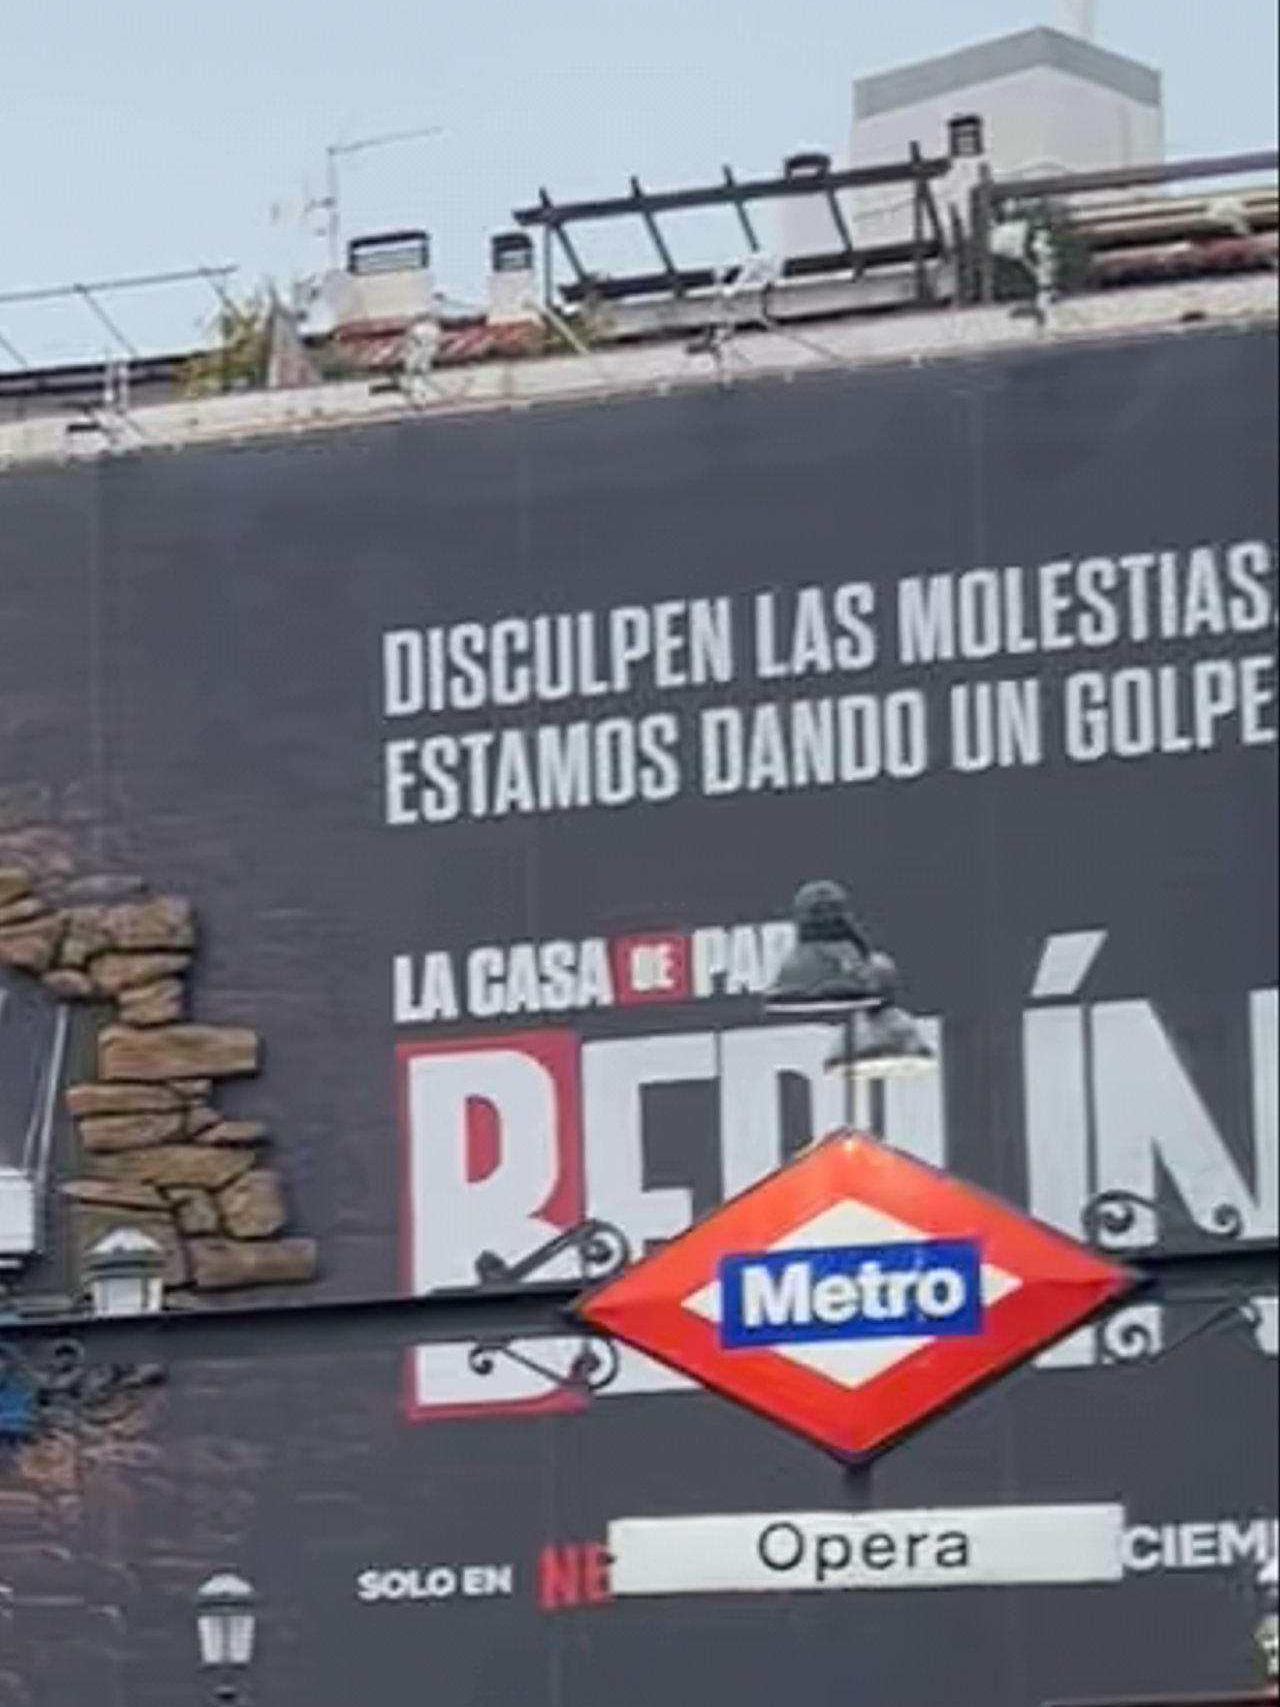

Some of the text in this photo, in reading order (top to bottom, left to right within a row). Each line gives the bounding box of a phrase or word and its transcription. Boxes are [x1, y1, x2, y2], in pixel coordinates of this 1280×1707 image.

[383, 540, 1278, 717] DISCULPEN LAS MOLESTIAS
[384, 655, 1278, 826] ESTAMOS DANDO UN GOLPE
[393, 950, 459, 1023] LA
[466, 937, 615, 1017] CASA
[630, 943, 676, 992] DE
[742, 1260, 968, 1328] Metro
[356, 1567, 457, 1601] SOLO
[463, 1565, 513, 1595] EN
[757, 1520, 968, 1582] Opera
